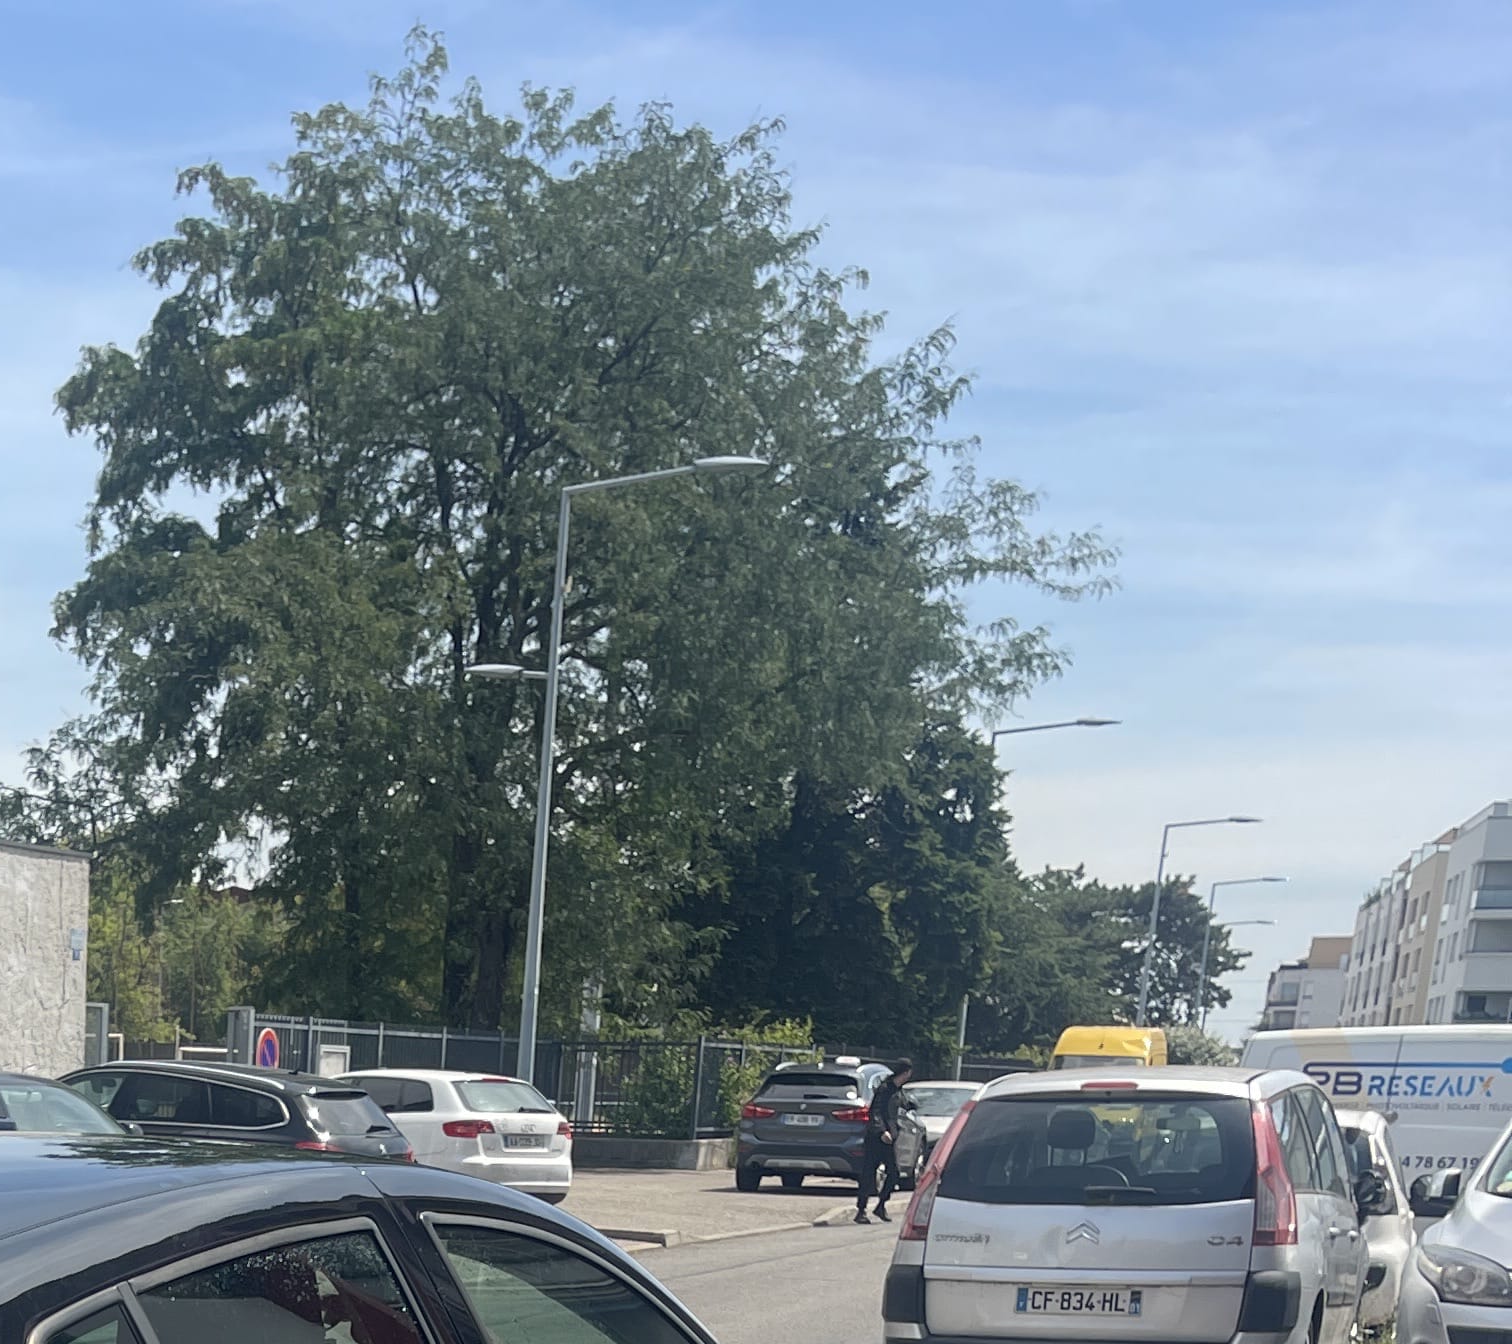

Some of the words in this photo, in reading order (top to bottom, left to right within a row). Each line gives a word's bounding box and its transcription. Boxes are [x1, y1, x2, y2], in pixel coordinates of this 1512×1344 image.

[1367, 1075, 1496, 1097] RESEAUX
[1415, 1155, 1433, 1169] 78
[1437, 1156, 1456, 1169] 67
